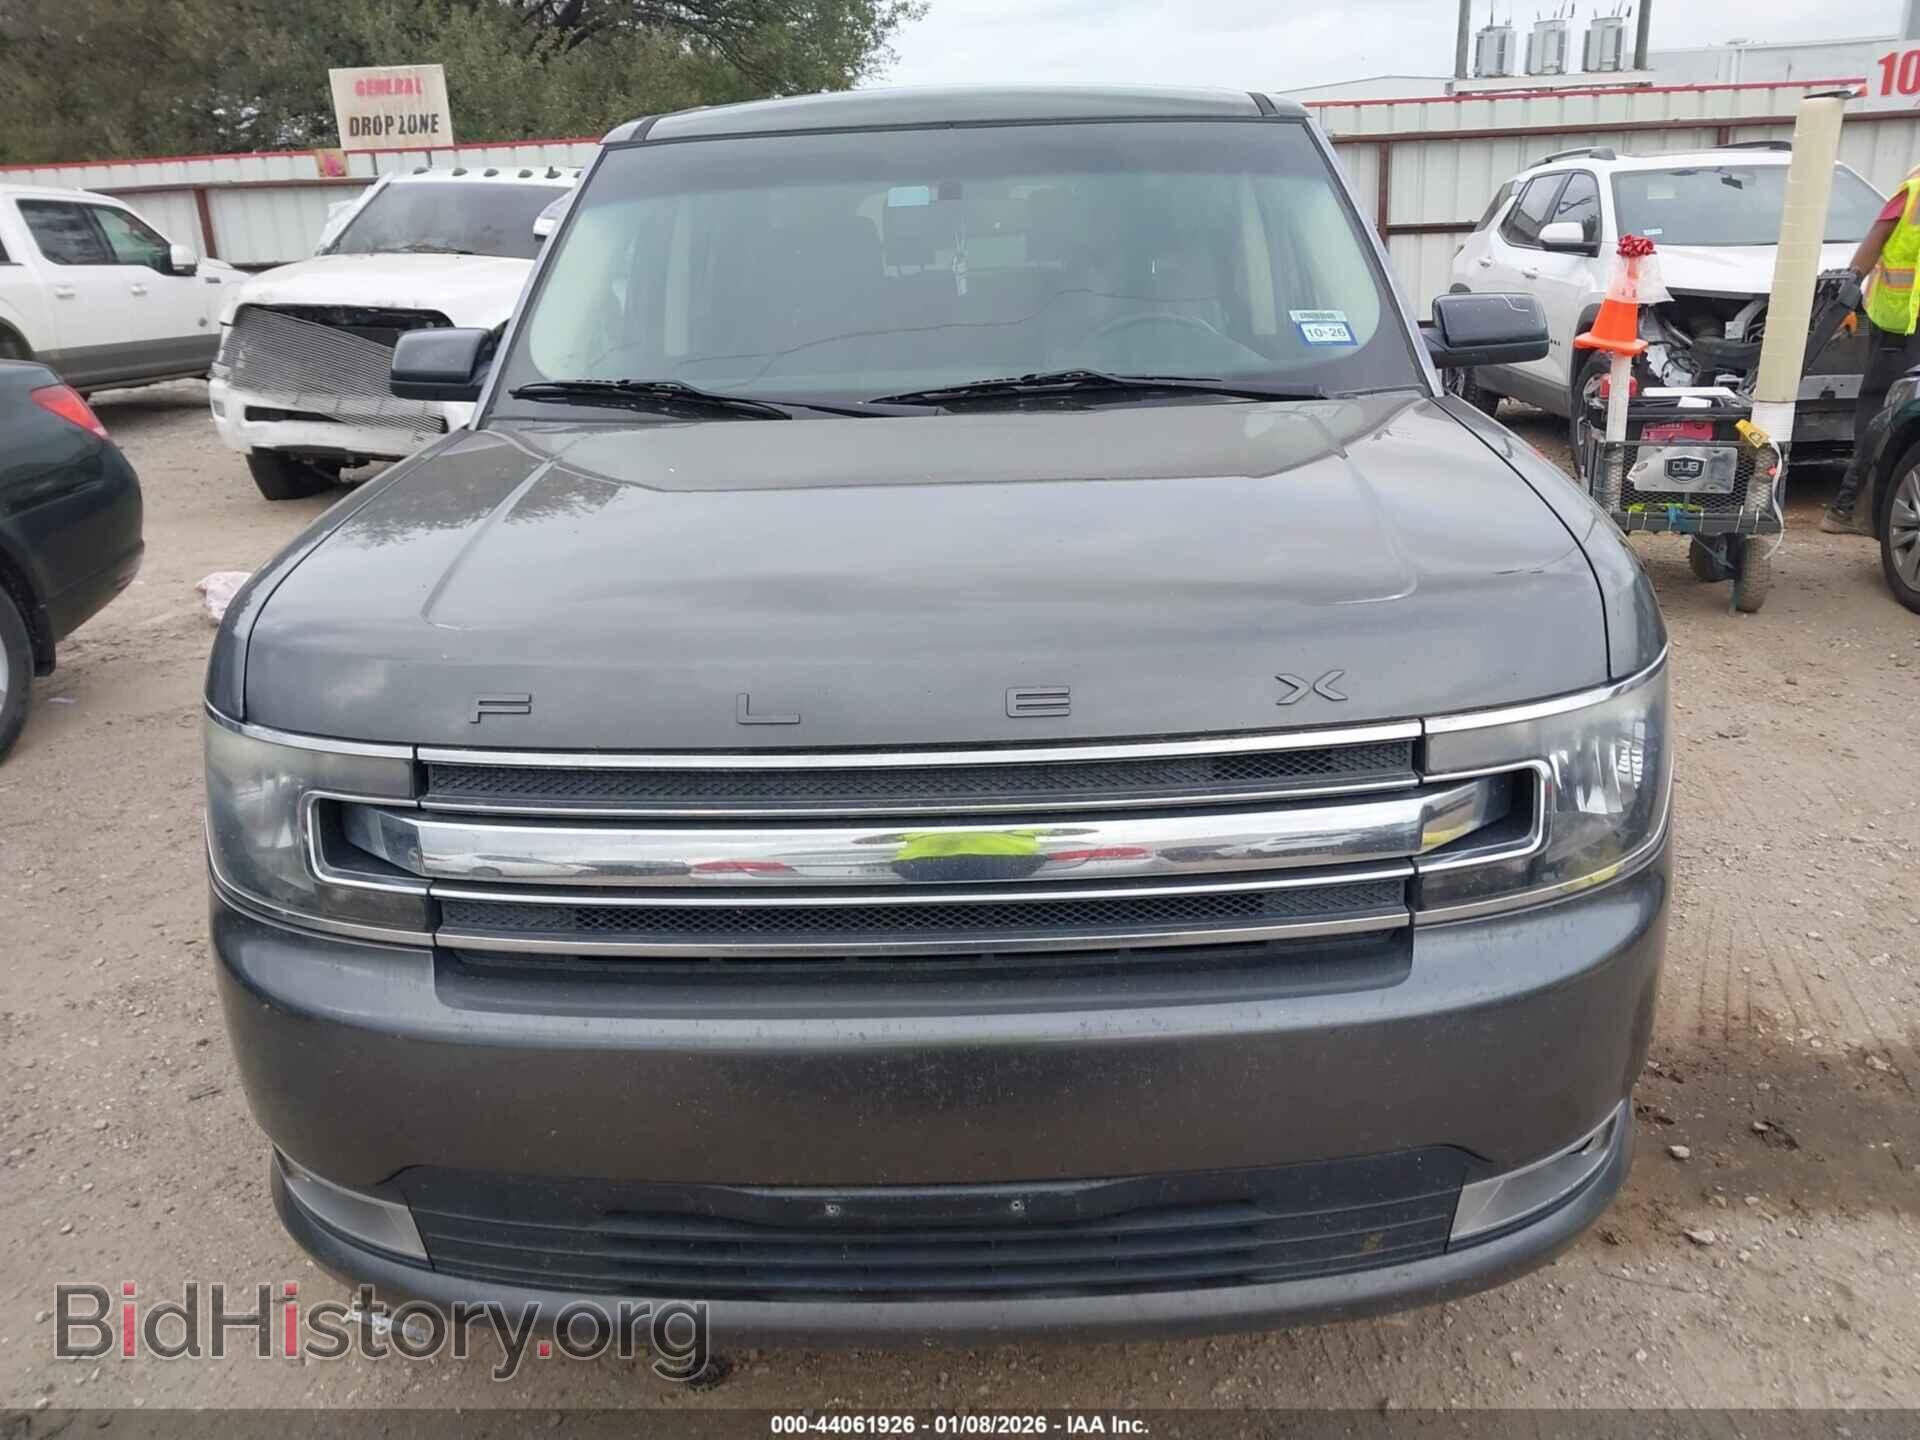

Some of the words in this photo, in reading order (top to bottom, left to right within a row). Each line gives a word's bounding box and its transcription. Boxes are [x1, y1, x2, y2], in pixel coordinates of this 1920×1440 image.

[355, 78, 422, 97] GENERAL
[350, 115, 394, 137] DROP
[398, 113, 439, 135] ZONE
